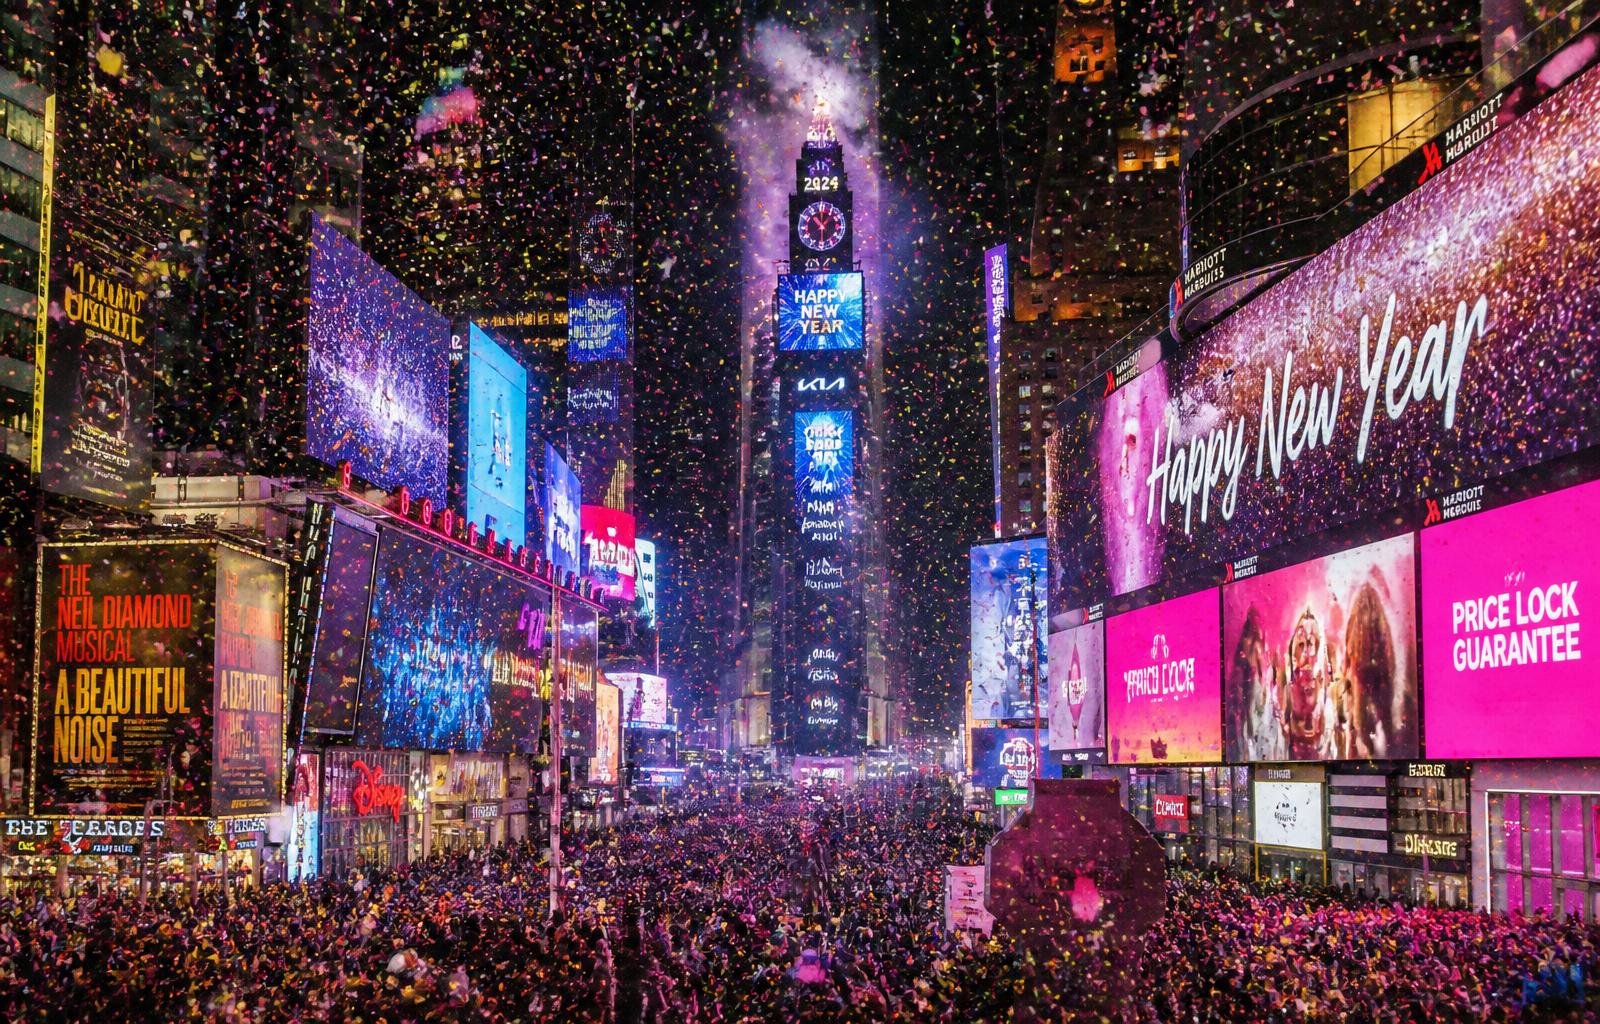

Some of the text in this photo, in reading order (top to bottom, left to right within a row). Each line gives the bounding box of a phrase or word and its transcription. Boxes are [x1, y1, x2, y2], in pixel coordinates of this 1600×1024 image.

[803, 176, 840, 193] 2024
[794, 289, 846, 304] HAPPY
[801, 304, 840, 319] NEW
[798, 319, 844, 335] YEAR
[1146, 291, 1488, 535] Happy New Year
[58, 564, 92, 596] THE
[57, 594, 192, 630] NEIL DIAMOND
[1452, 580, 1580, 634] PRICE LOCK
[56, 630, 135, 663] MUSICAL
[1453, 622, 1582, 672] GUARANTEE
[54, 667, 191, 715] A BEAUTIFUL
[53, 715, 119, 764] NOISE
